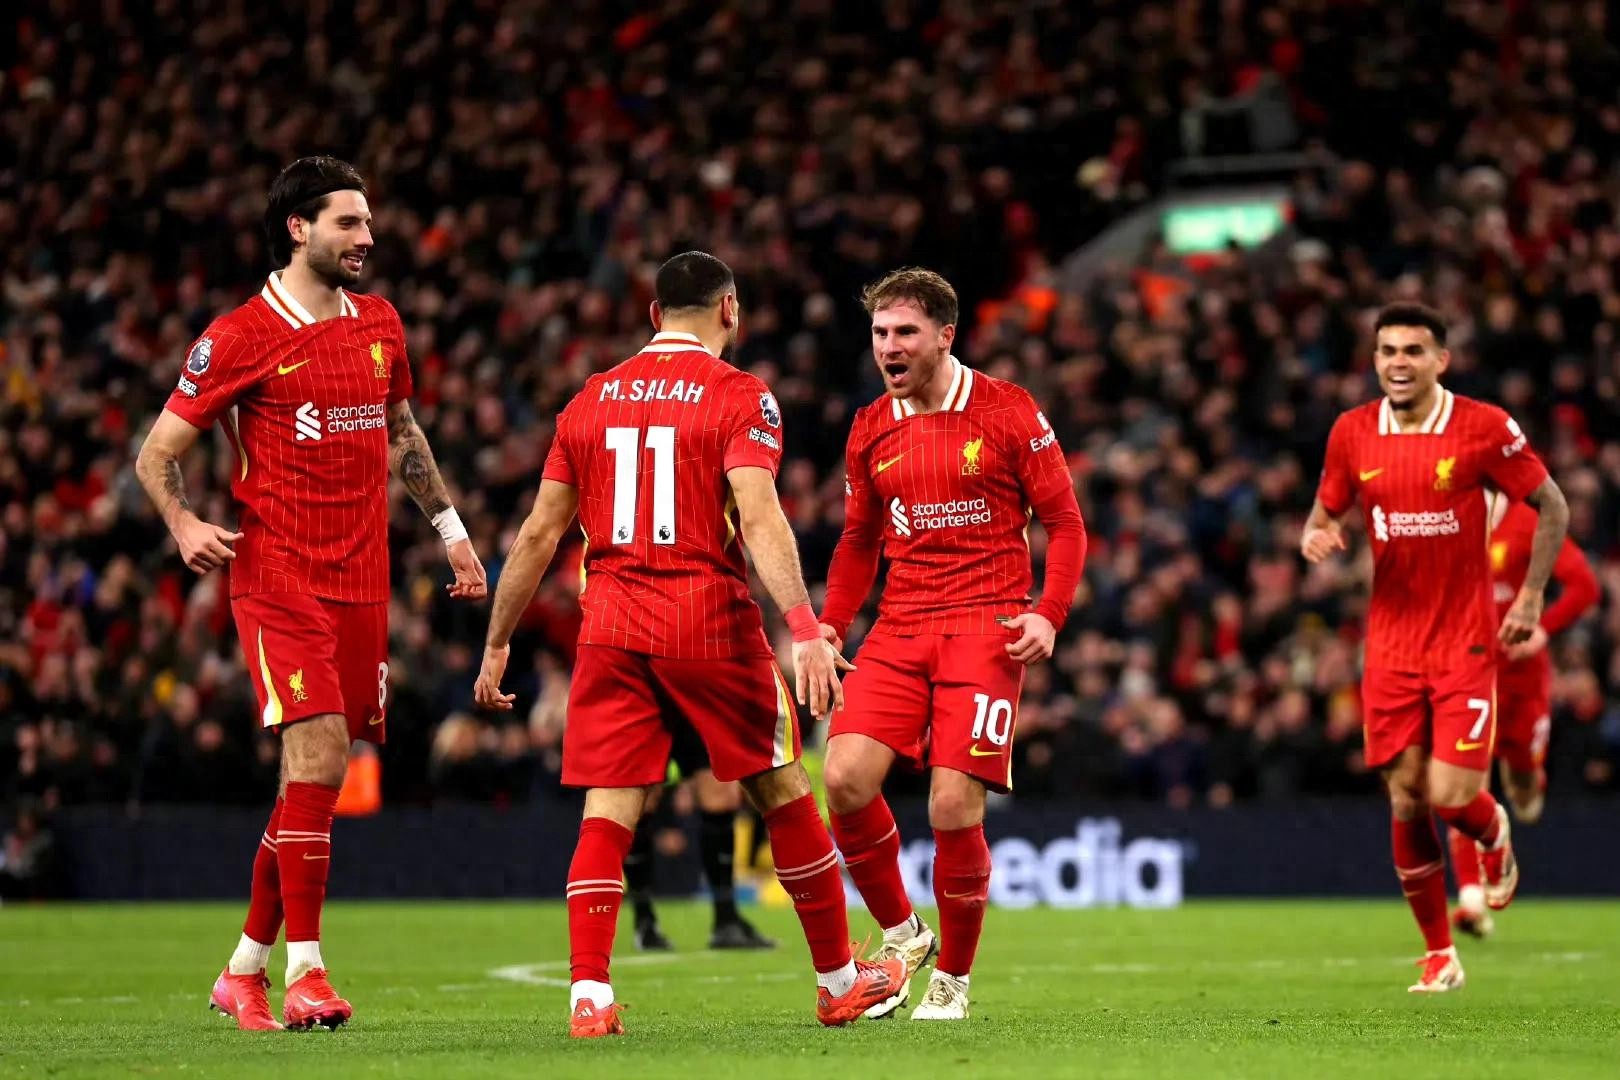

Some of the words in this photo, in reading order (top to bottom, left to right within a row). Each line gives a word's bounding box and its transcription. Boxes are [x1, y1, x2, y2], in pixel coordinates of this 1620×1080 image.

[328, 413, 385, 433] chartered
[605, 425, 676, 545] 11
[912, 497, 985, 517] standard
[1389, 508, 1455, 525] standard
[913, 509, 991, 530] chartered
[1389, 519, 1460, 537] chartered
[378, 661, 389, 709] 8
[971, 693, 1012, 746] 10
[1467, 698, 1489, 739] 7
